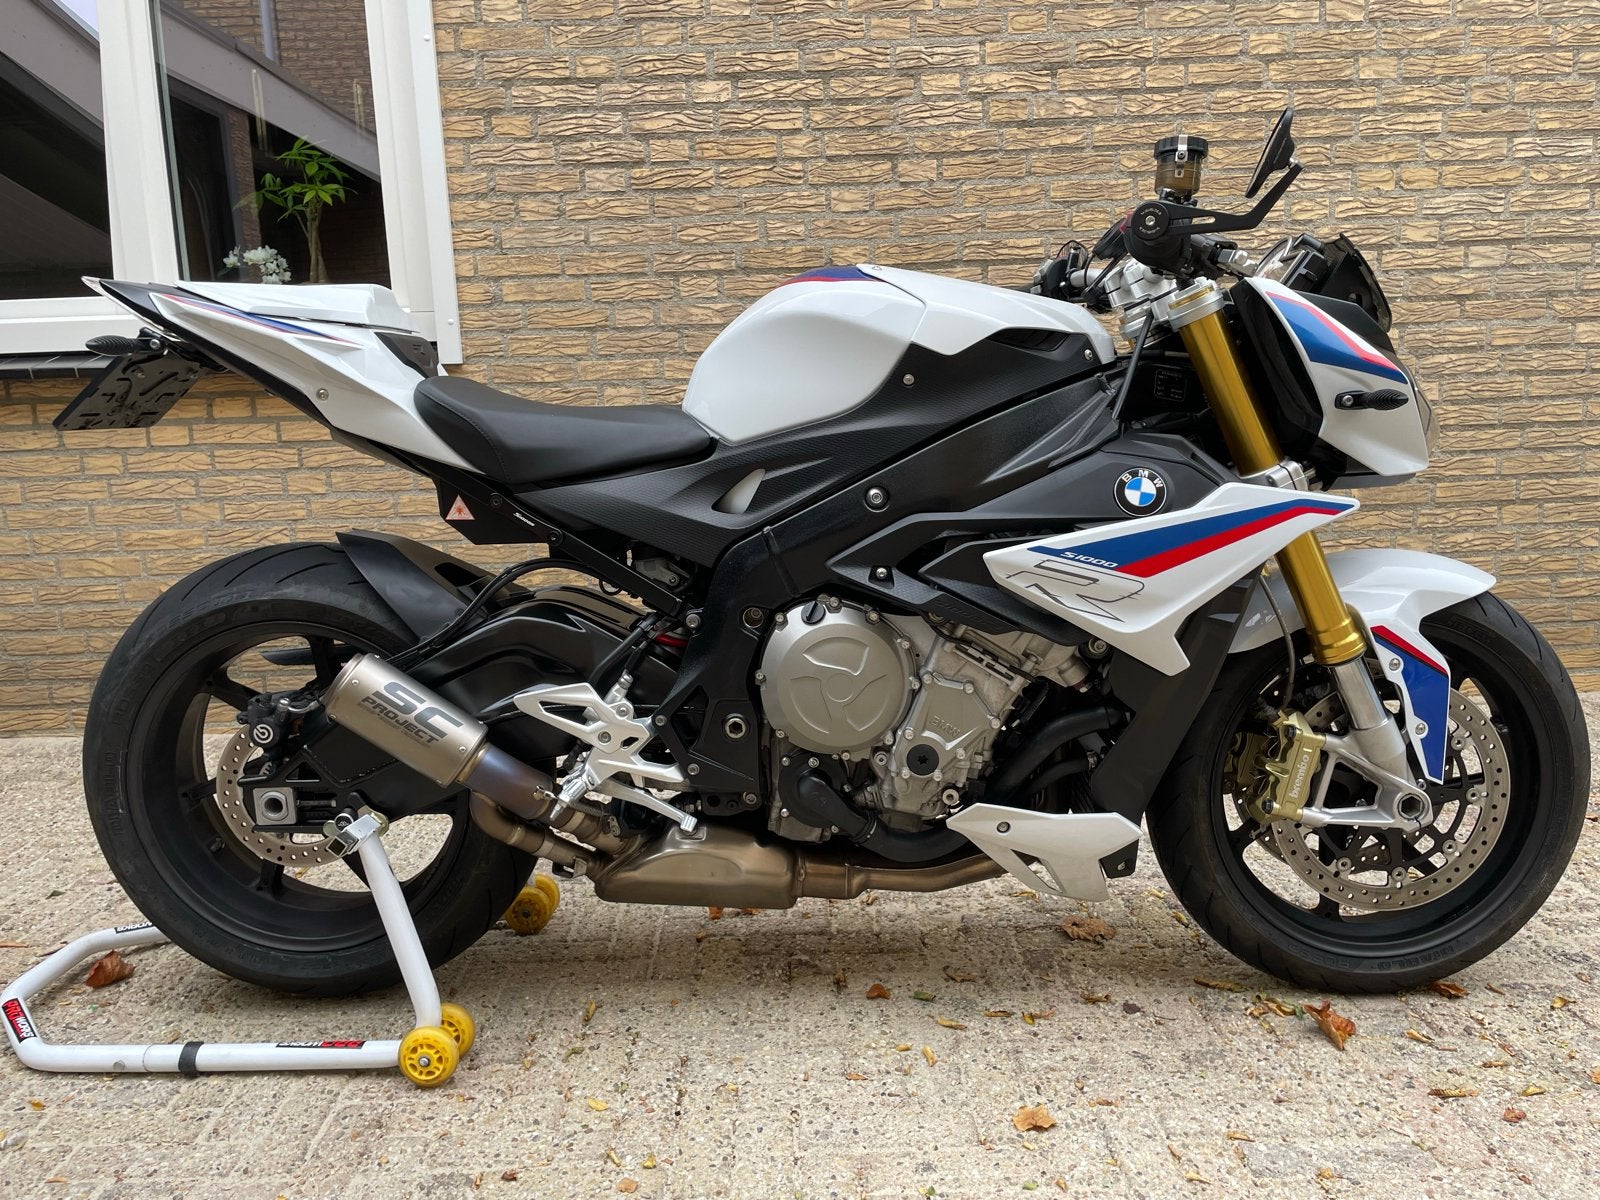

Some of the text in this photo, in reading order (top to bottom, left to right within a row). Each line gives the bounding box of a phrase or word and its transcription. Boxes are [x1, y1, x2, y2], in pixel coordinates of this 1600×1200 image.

[1121, 469, 1163, 487] BMW
[1060, 551, 1118, 568] S1000
[361, 696, 439, 744] PROJECT
[372, 681, 464, 739] SC
[1288, 754, 1309, 799] brembo
